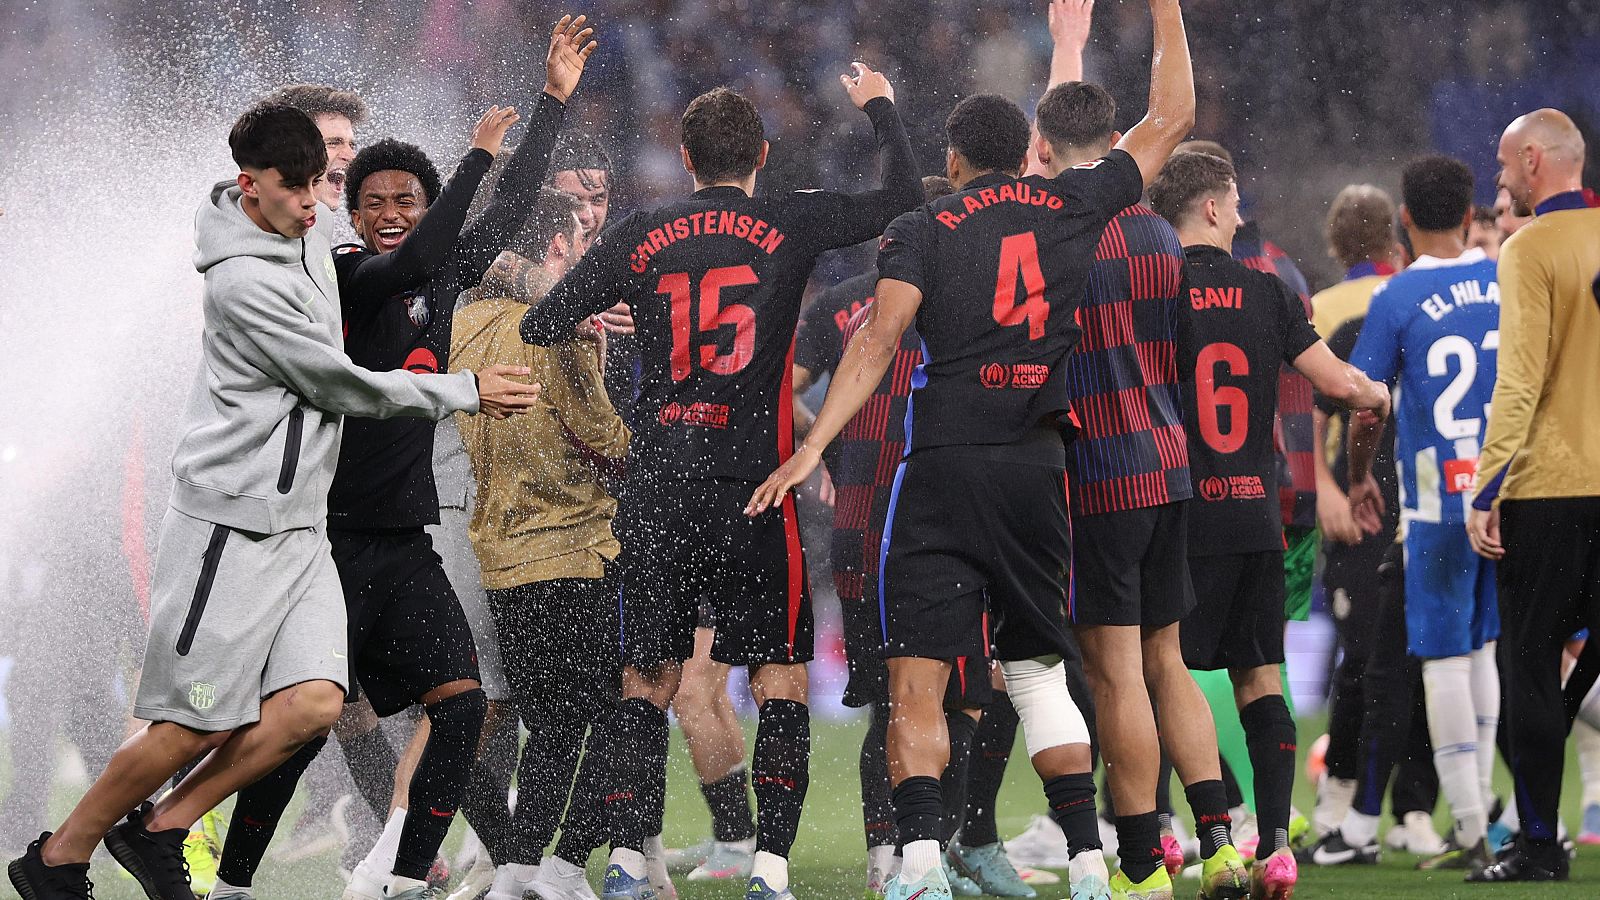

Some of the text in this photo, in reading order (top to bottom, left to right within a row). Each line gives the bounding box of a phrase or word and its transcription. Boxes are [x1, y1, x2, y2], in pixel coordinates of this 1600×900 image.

[630, 210, 785, 274] CHRISTENSEN
[992, 231, 1050, 341] 4
[1189, 287, 1243, 310] GAVI
[1421, 293, 1455, 321] EL
[656, 264, 760, 381] 15
[1012, 363, 1049, 375] UNHCR
[1195, 342, 1249, 454] 6
